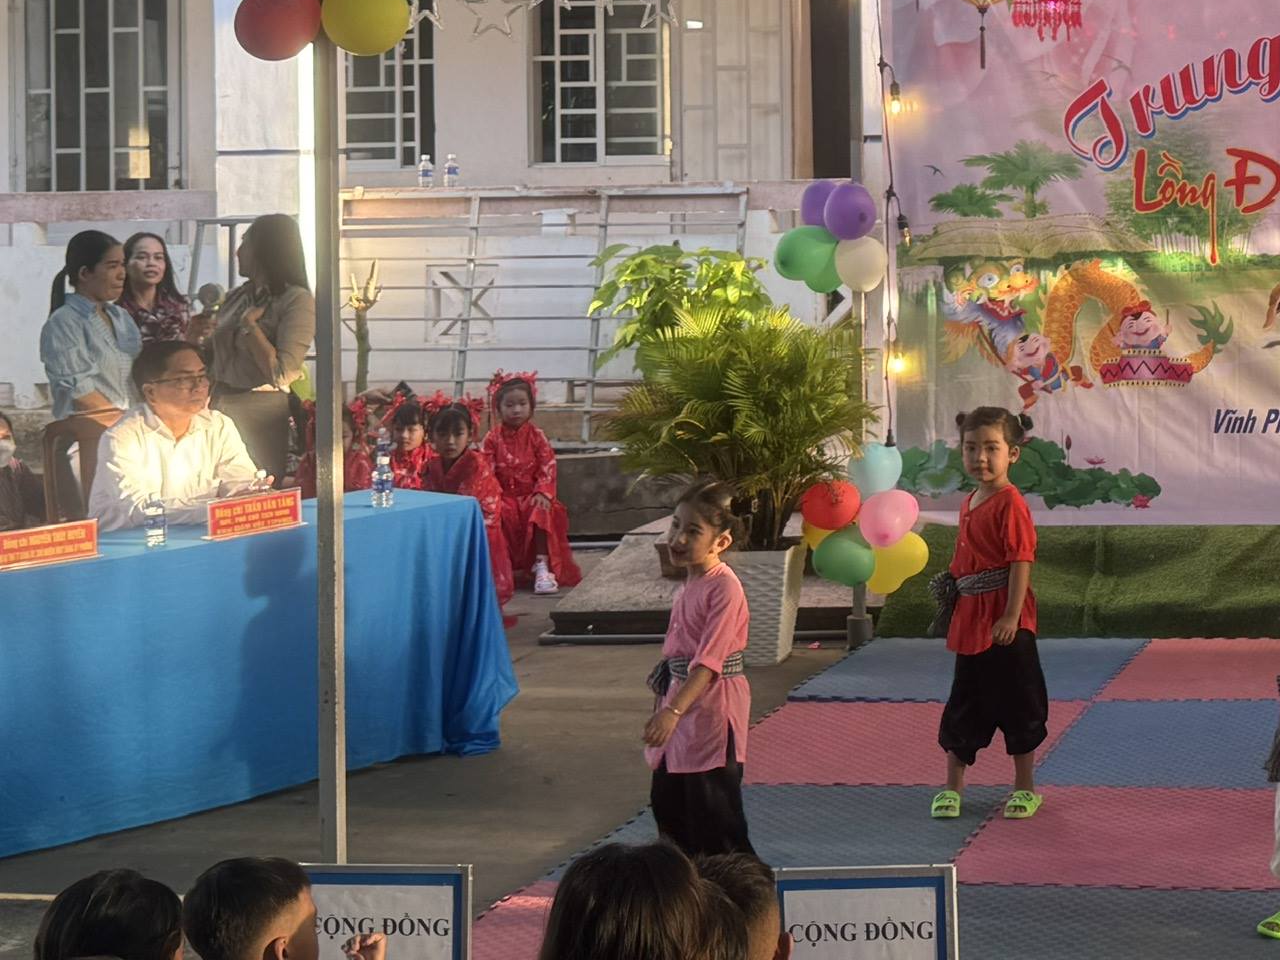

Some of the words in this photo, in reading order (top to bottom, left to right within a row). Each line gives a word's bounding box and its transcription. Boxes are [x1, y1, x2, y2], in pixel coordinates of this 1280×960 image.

[1132, 148, 1218, 265] Lồng
[1213, 408, 1258, 434] Vĩnh
[382, 913, 450, 936] ĐỒNG
[789, 921, 857, 947] CỘNG
[864, 916, 934, 941] ĐỒNG
